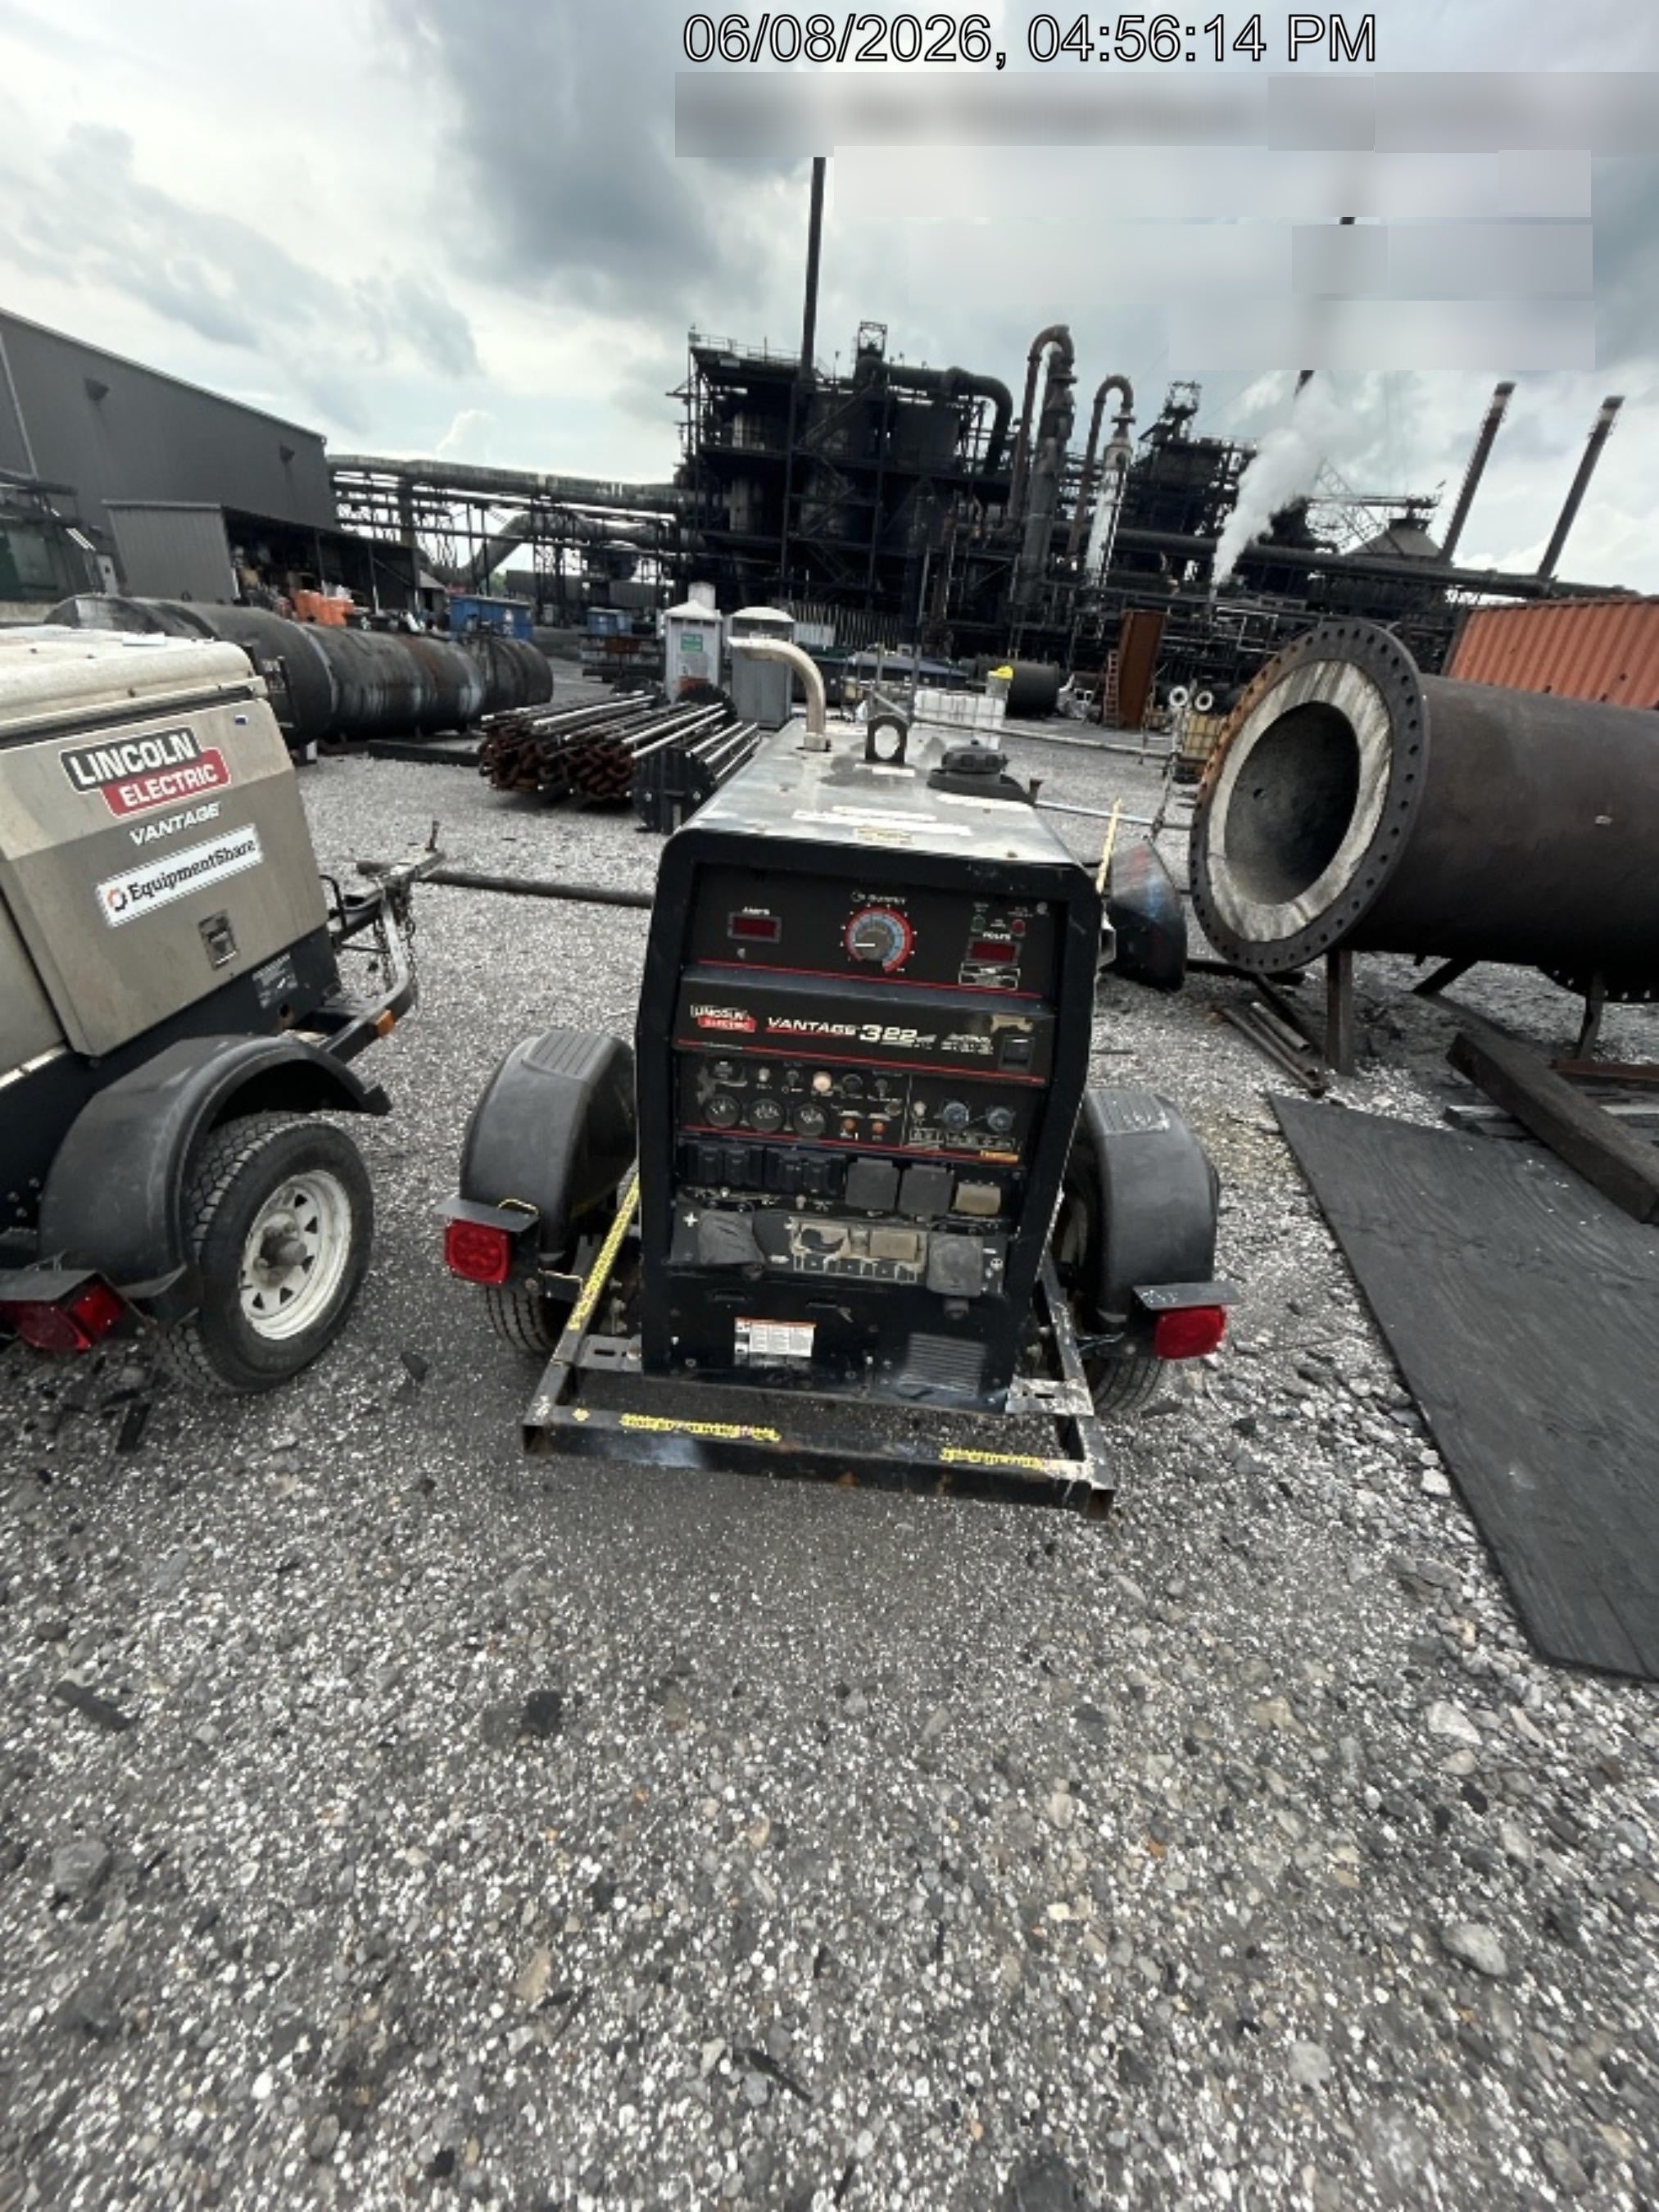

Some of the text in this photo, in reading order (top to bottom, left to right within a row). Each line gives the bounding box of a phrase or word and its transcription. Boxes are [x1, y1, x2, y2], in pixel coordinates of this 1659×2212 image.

[70, 732, 197, 785] LINCOLN
[119, 764, 220, 808] ELECTRIC
[129, 801, 222, 846] VANTAGE
[127, 839, 256, 902] EquipmentShare
[768, 1016, 857, 1036] VANTAGE
